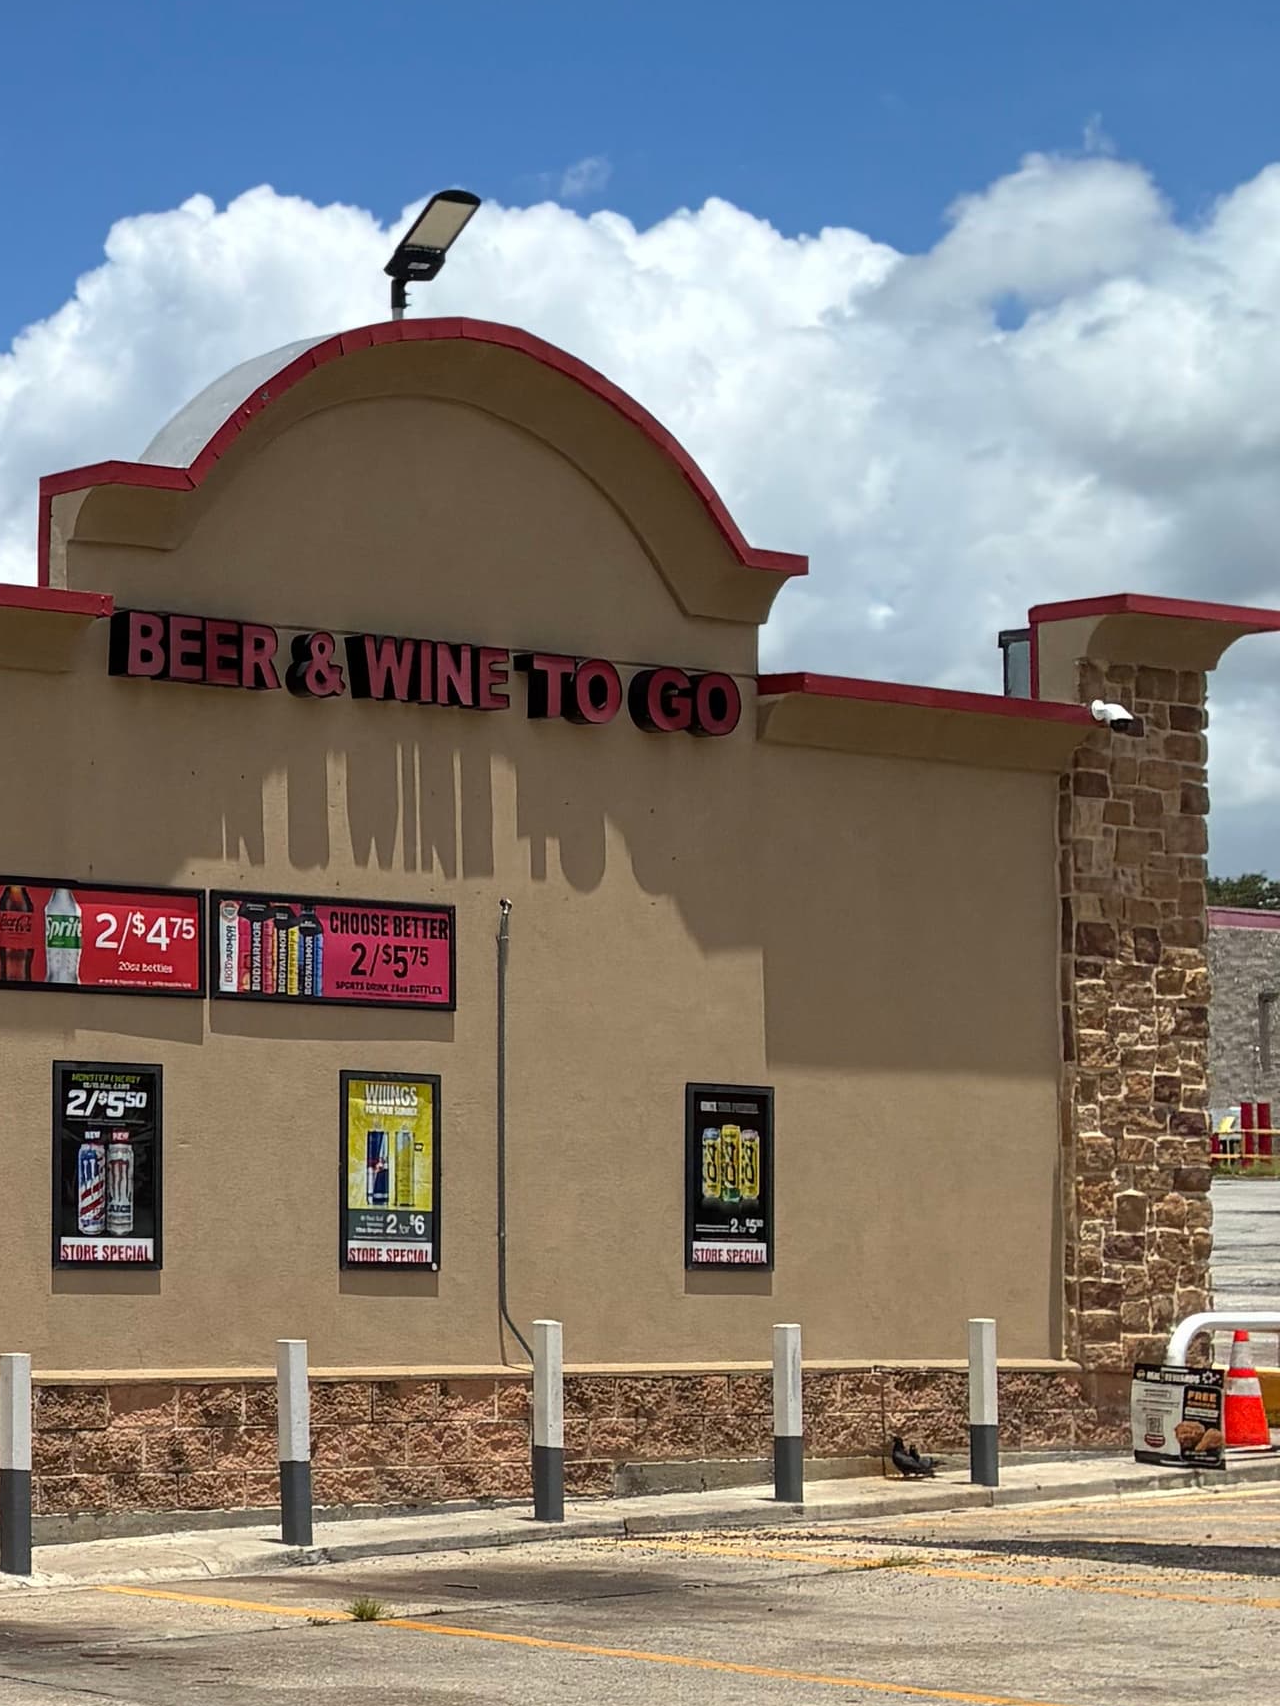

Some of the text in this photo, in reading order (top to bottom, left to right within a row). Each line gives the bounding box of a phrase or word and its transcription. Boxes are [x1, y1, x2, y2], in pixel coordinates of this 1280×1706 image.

[120, 610, 741, 736] BEER & WINE TO GO
[392, 915, 449, 941] BETTER
[385, 1214, 398, 1234] 2
[409, 1213, 426, 1236] $6
[730, 1218, 739, 1234] 2
[62, 1243, 150, 1262] STORE SPECIAL
[348, 1247, 428, 1263] STORE SPECIAL
[693, 1247, 766, 1264] STORE SPECIAL
[1187, 1389, 1217, 1403] FREE
